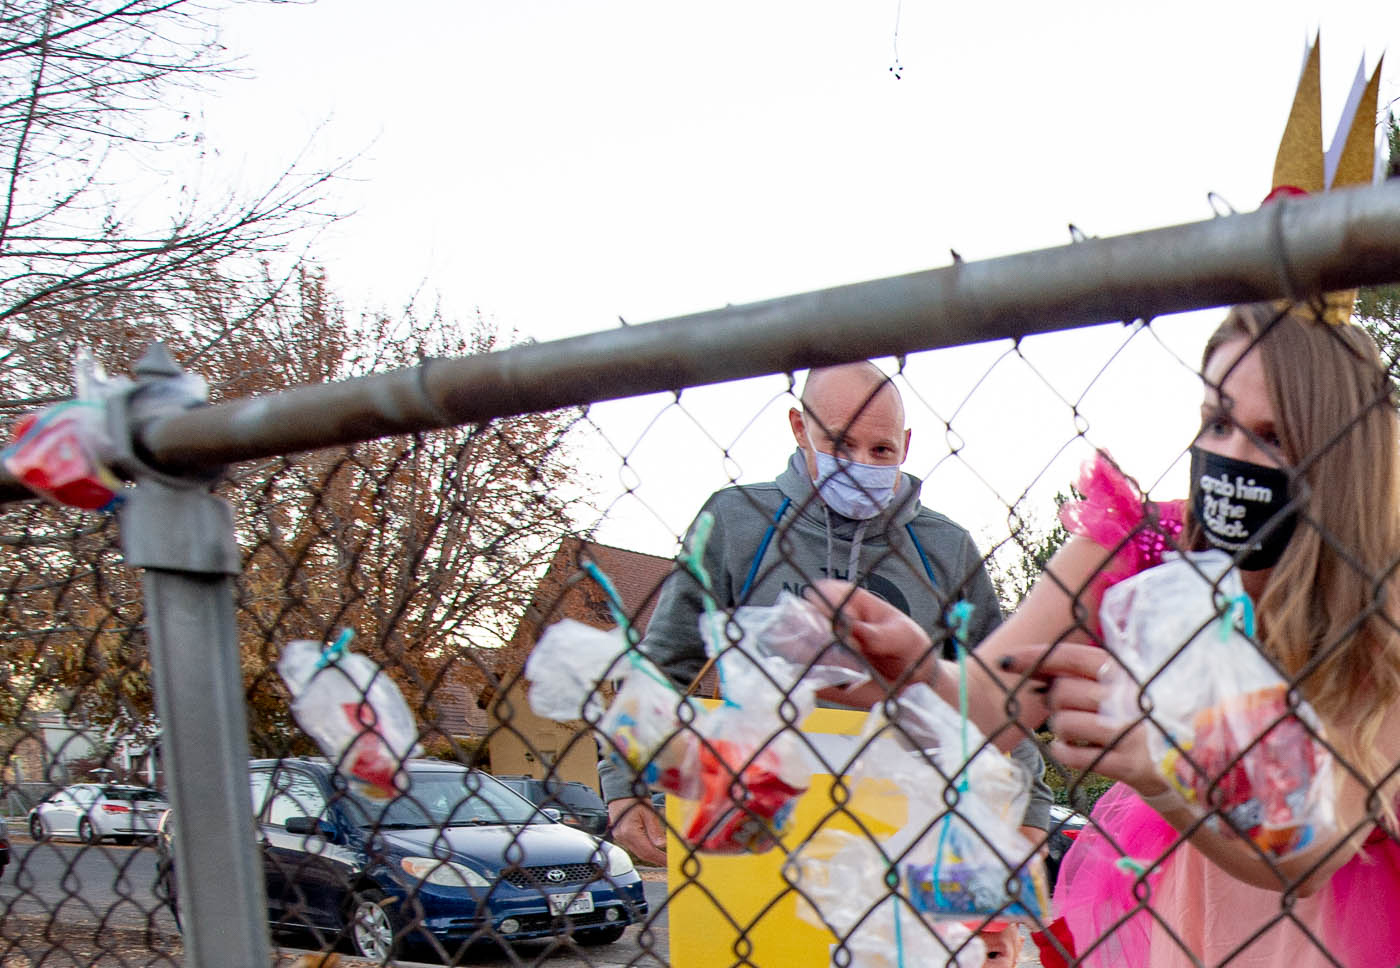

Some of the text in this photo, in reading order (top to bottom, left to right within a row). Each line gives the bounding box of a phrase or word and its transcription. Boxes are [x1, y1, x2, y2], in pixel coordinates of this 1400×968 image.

[1200, 473, 1273, 503] grab him
[1219, 496, 1247, 519] the
